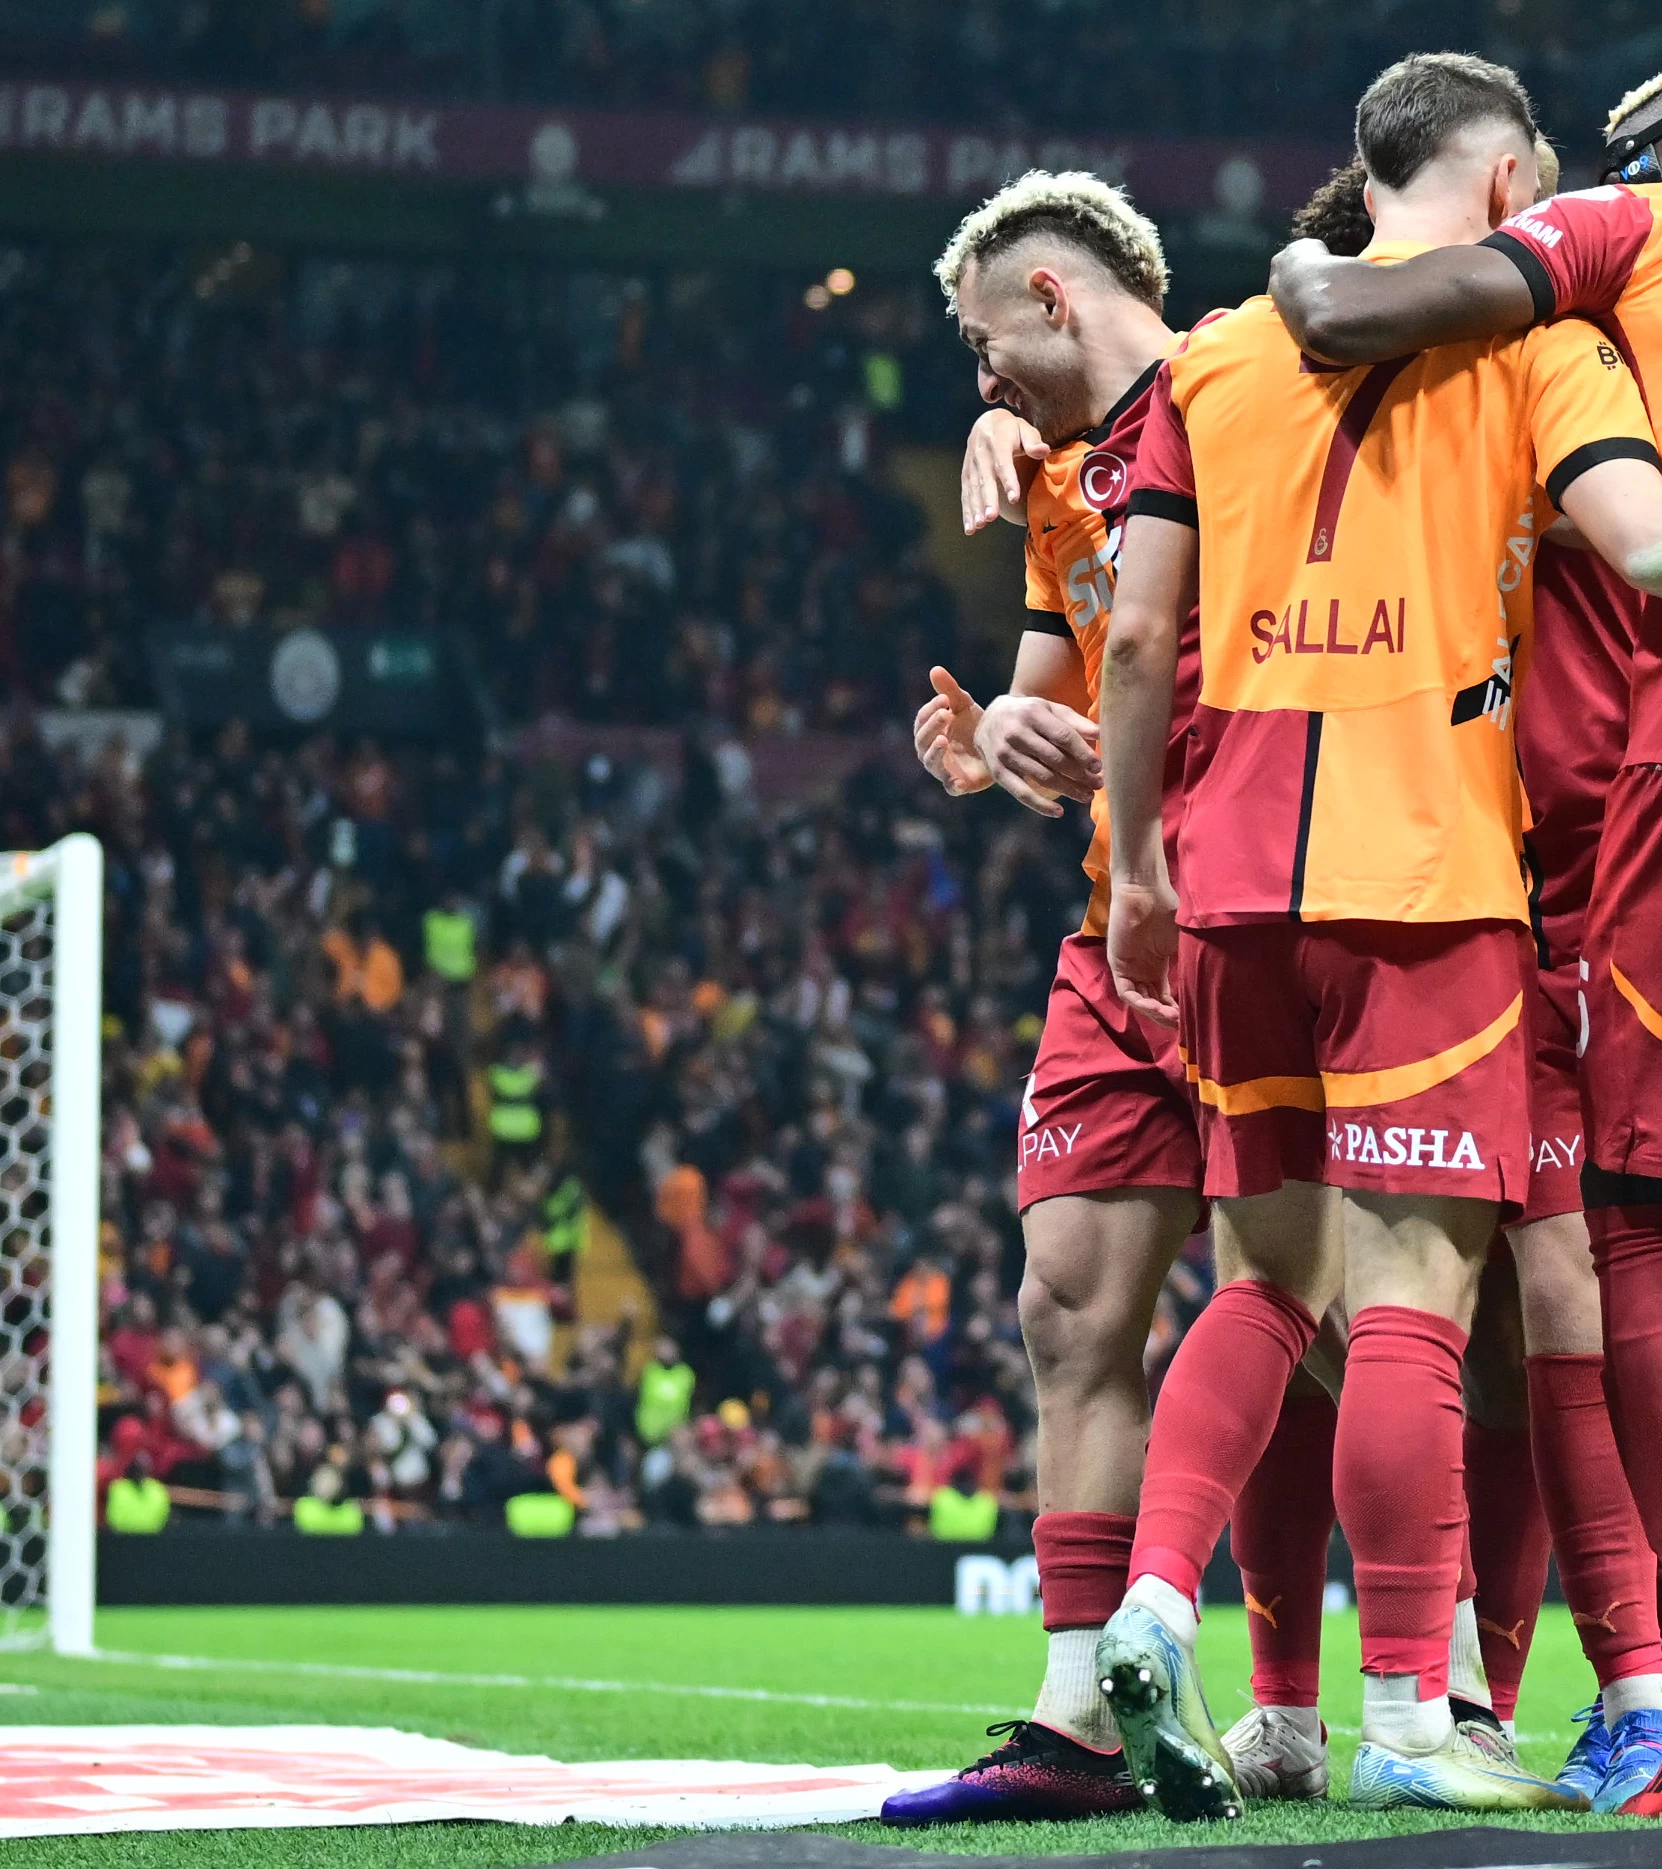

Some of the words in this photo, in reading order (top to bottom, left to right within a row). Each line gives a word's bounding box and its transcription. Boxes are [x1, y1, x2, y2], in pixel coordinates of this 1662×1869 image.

[24, 86, 228, 156] RAMS
[250, 99, 441, 167] PARK
[730, 126, 928, 192] RAMS
[1250, 597, 1405, 664] SALLAI
[1017, 1123, 1082, 1173] PAY
[1344, 1123, 1486, 1171] PASHA
